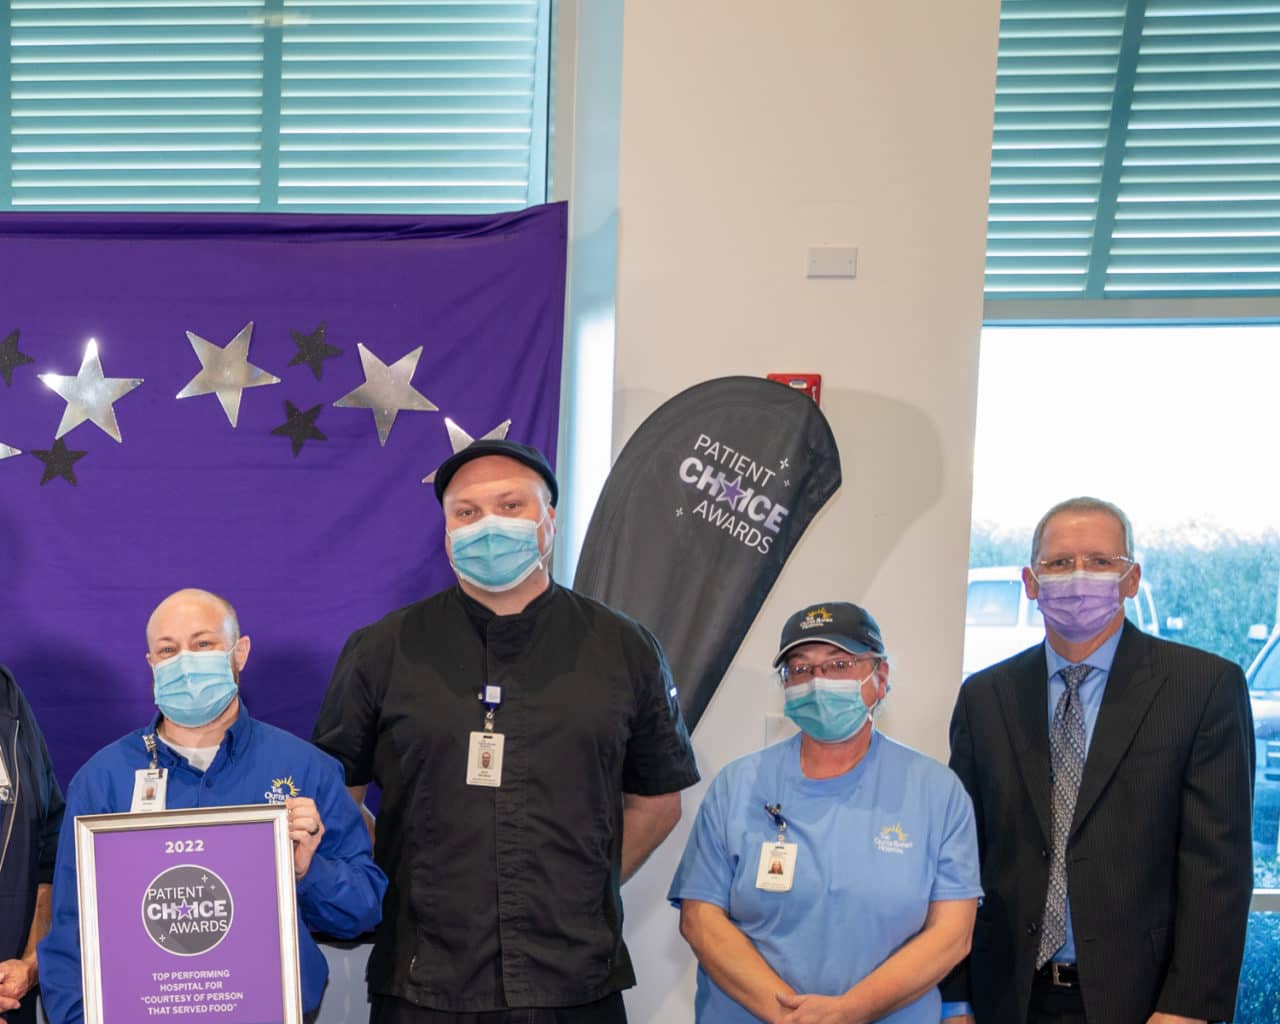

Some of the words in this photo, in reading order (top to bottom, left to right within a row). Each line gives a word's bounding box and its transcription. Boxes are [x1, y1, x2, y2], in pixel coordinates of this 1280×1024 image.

[693, 433, 776, 488] PATIENT
[692, 500, 773, 554] AWARDS
[165, 839, 205, 853] 2022
[148, 885, 205, 900] PATIENT
[168, 919, 228, 934] AWARDS
[152, 972, 170, 981] TOP
[171, 969, 230, 980] PERFORMING
[160, 982, 203, 992] HOSPITAL
[205, 981, 223, 990] FOR
[193, 993, 206, 1002] OF
[207, 991, 244, 1001] PERSON
[147, 1006, 171, 1015] THAT
[172, 1005, 208, 1014] SERVED
